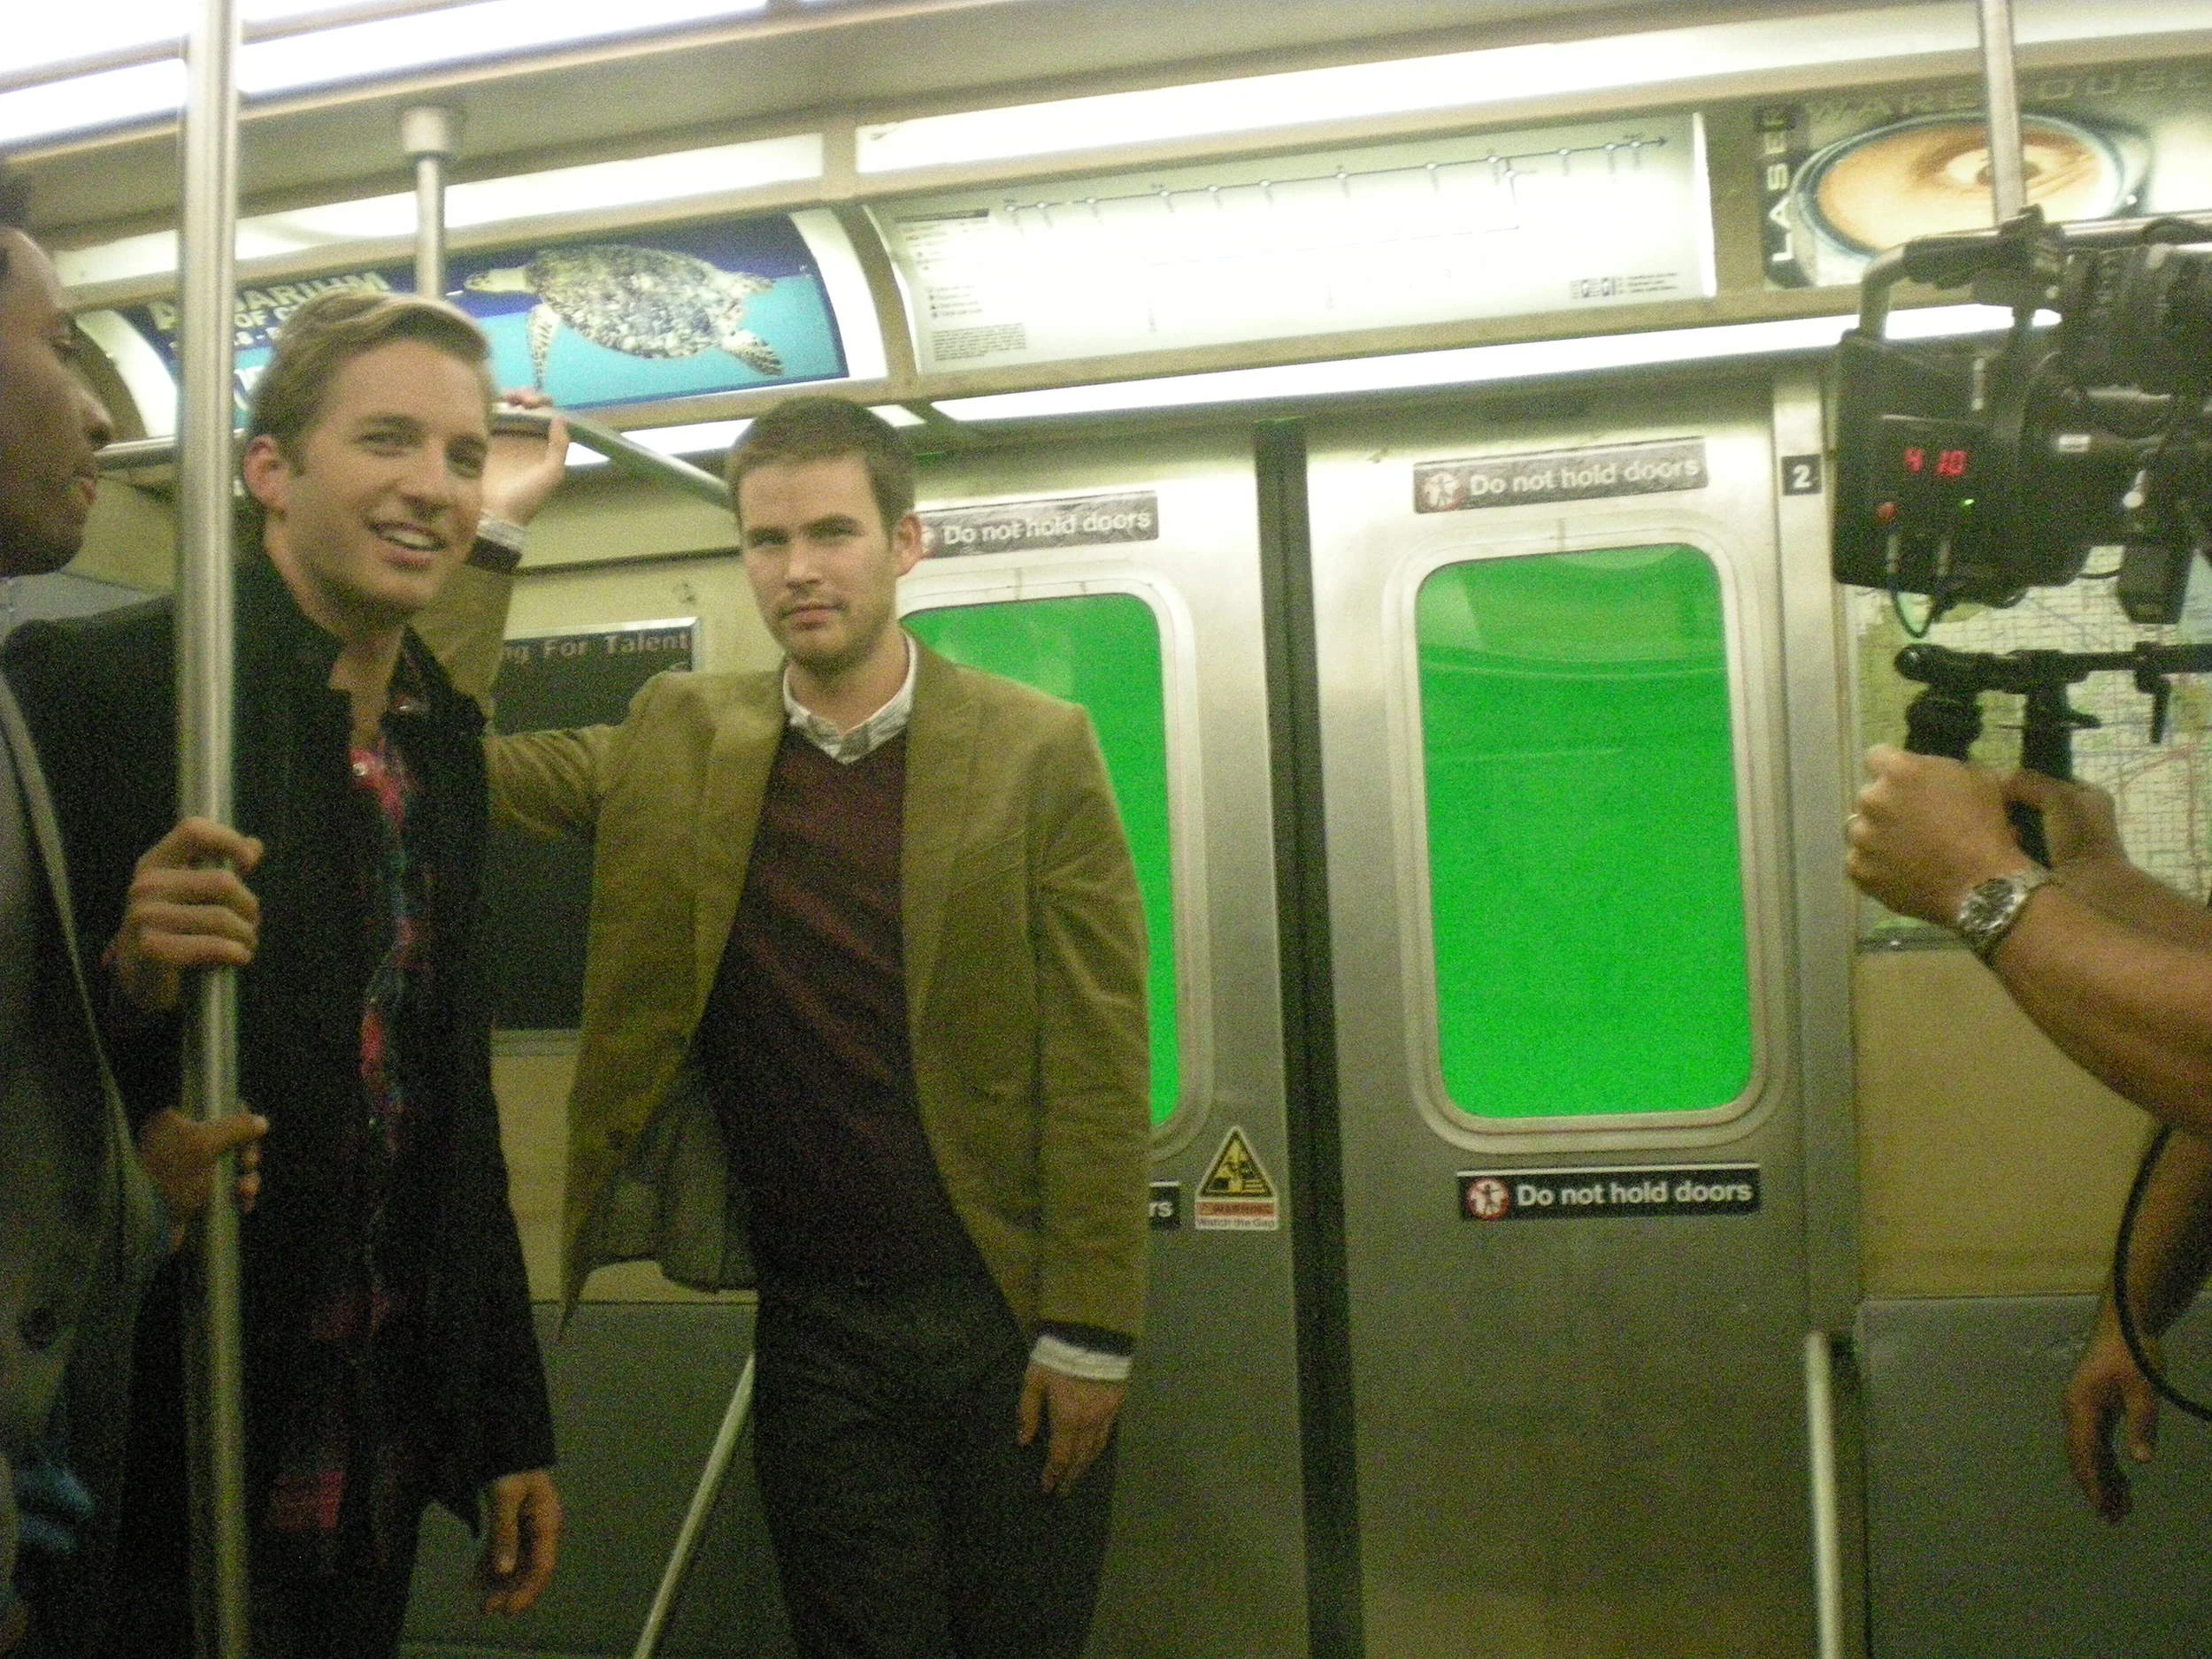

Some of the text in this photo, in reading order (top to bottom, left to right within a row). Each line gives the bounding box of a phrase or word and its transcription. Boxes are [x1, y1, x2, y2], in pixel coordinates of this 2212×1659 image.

[1804, 67, 2208, 117] WAREOUSE
[1763, 107, 1793, 262] LASER
[147, 271, 391, 330] AARIUM
[1470, 457, 1700, 495] Do not hold doors
[1793, 464, 1813, 488] 2
[944, 510, 1151, 544] Do not hold doors
[543, 638, 588, 658] For
[604, 631, 689, 655] Talent
[1516, 1179, 1753, 1206] Do not hold doors
